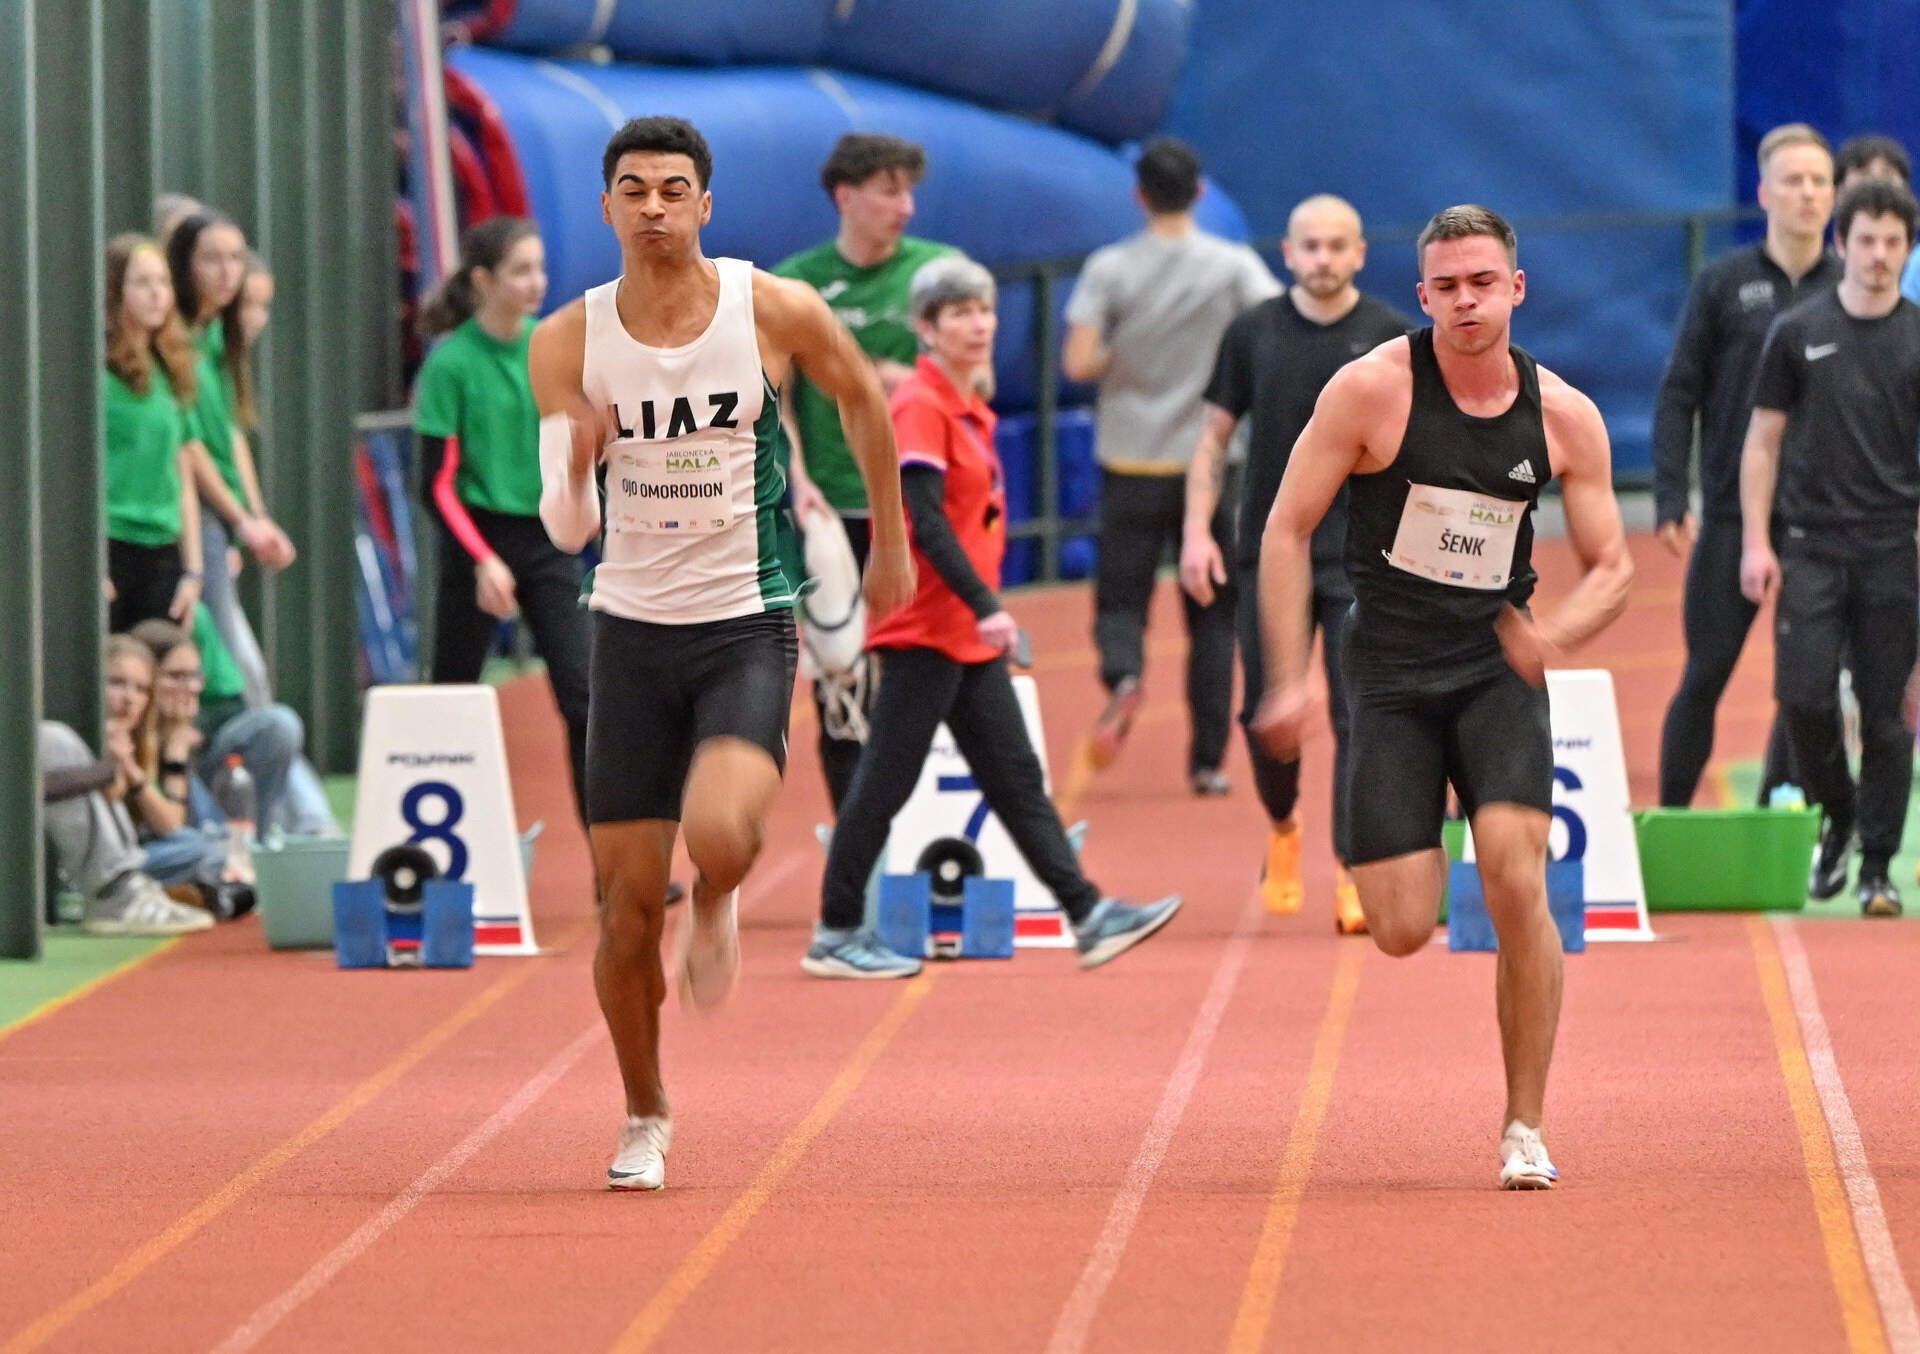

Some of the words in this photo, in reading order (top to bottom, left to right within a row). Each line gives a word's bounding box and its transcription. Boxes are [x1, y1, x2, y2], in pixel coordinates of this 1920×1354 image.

[608, 391, 739, 439] LIAZ
[666, 456, 720, 469] HALA
[1508, 471, 1536, 484] adidas
[622, 478, 638, 496] OJO
[640, 482, 723, 499] OMORODION
[1469, 510, 1514, 524] HALA
[1438, 528, 1487, 557] ŠENK
[402, 780, 468, 882] 8
